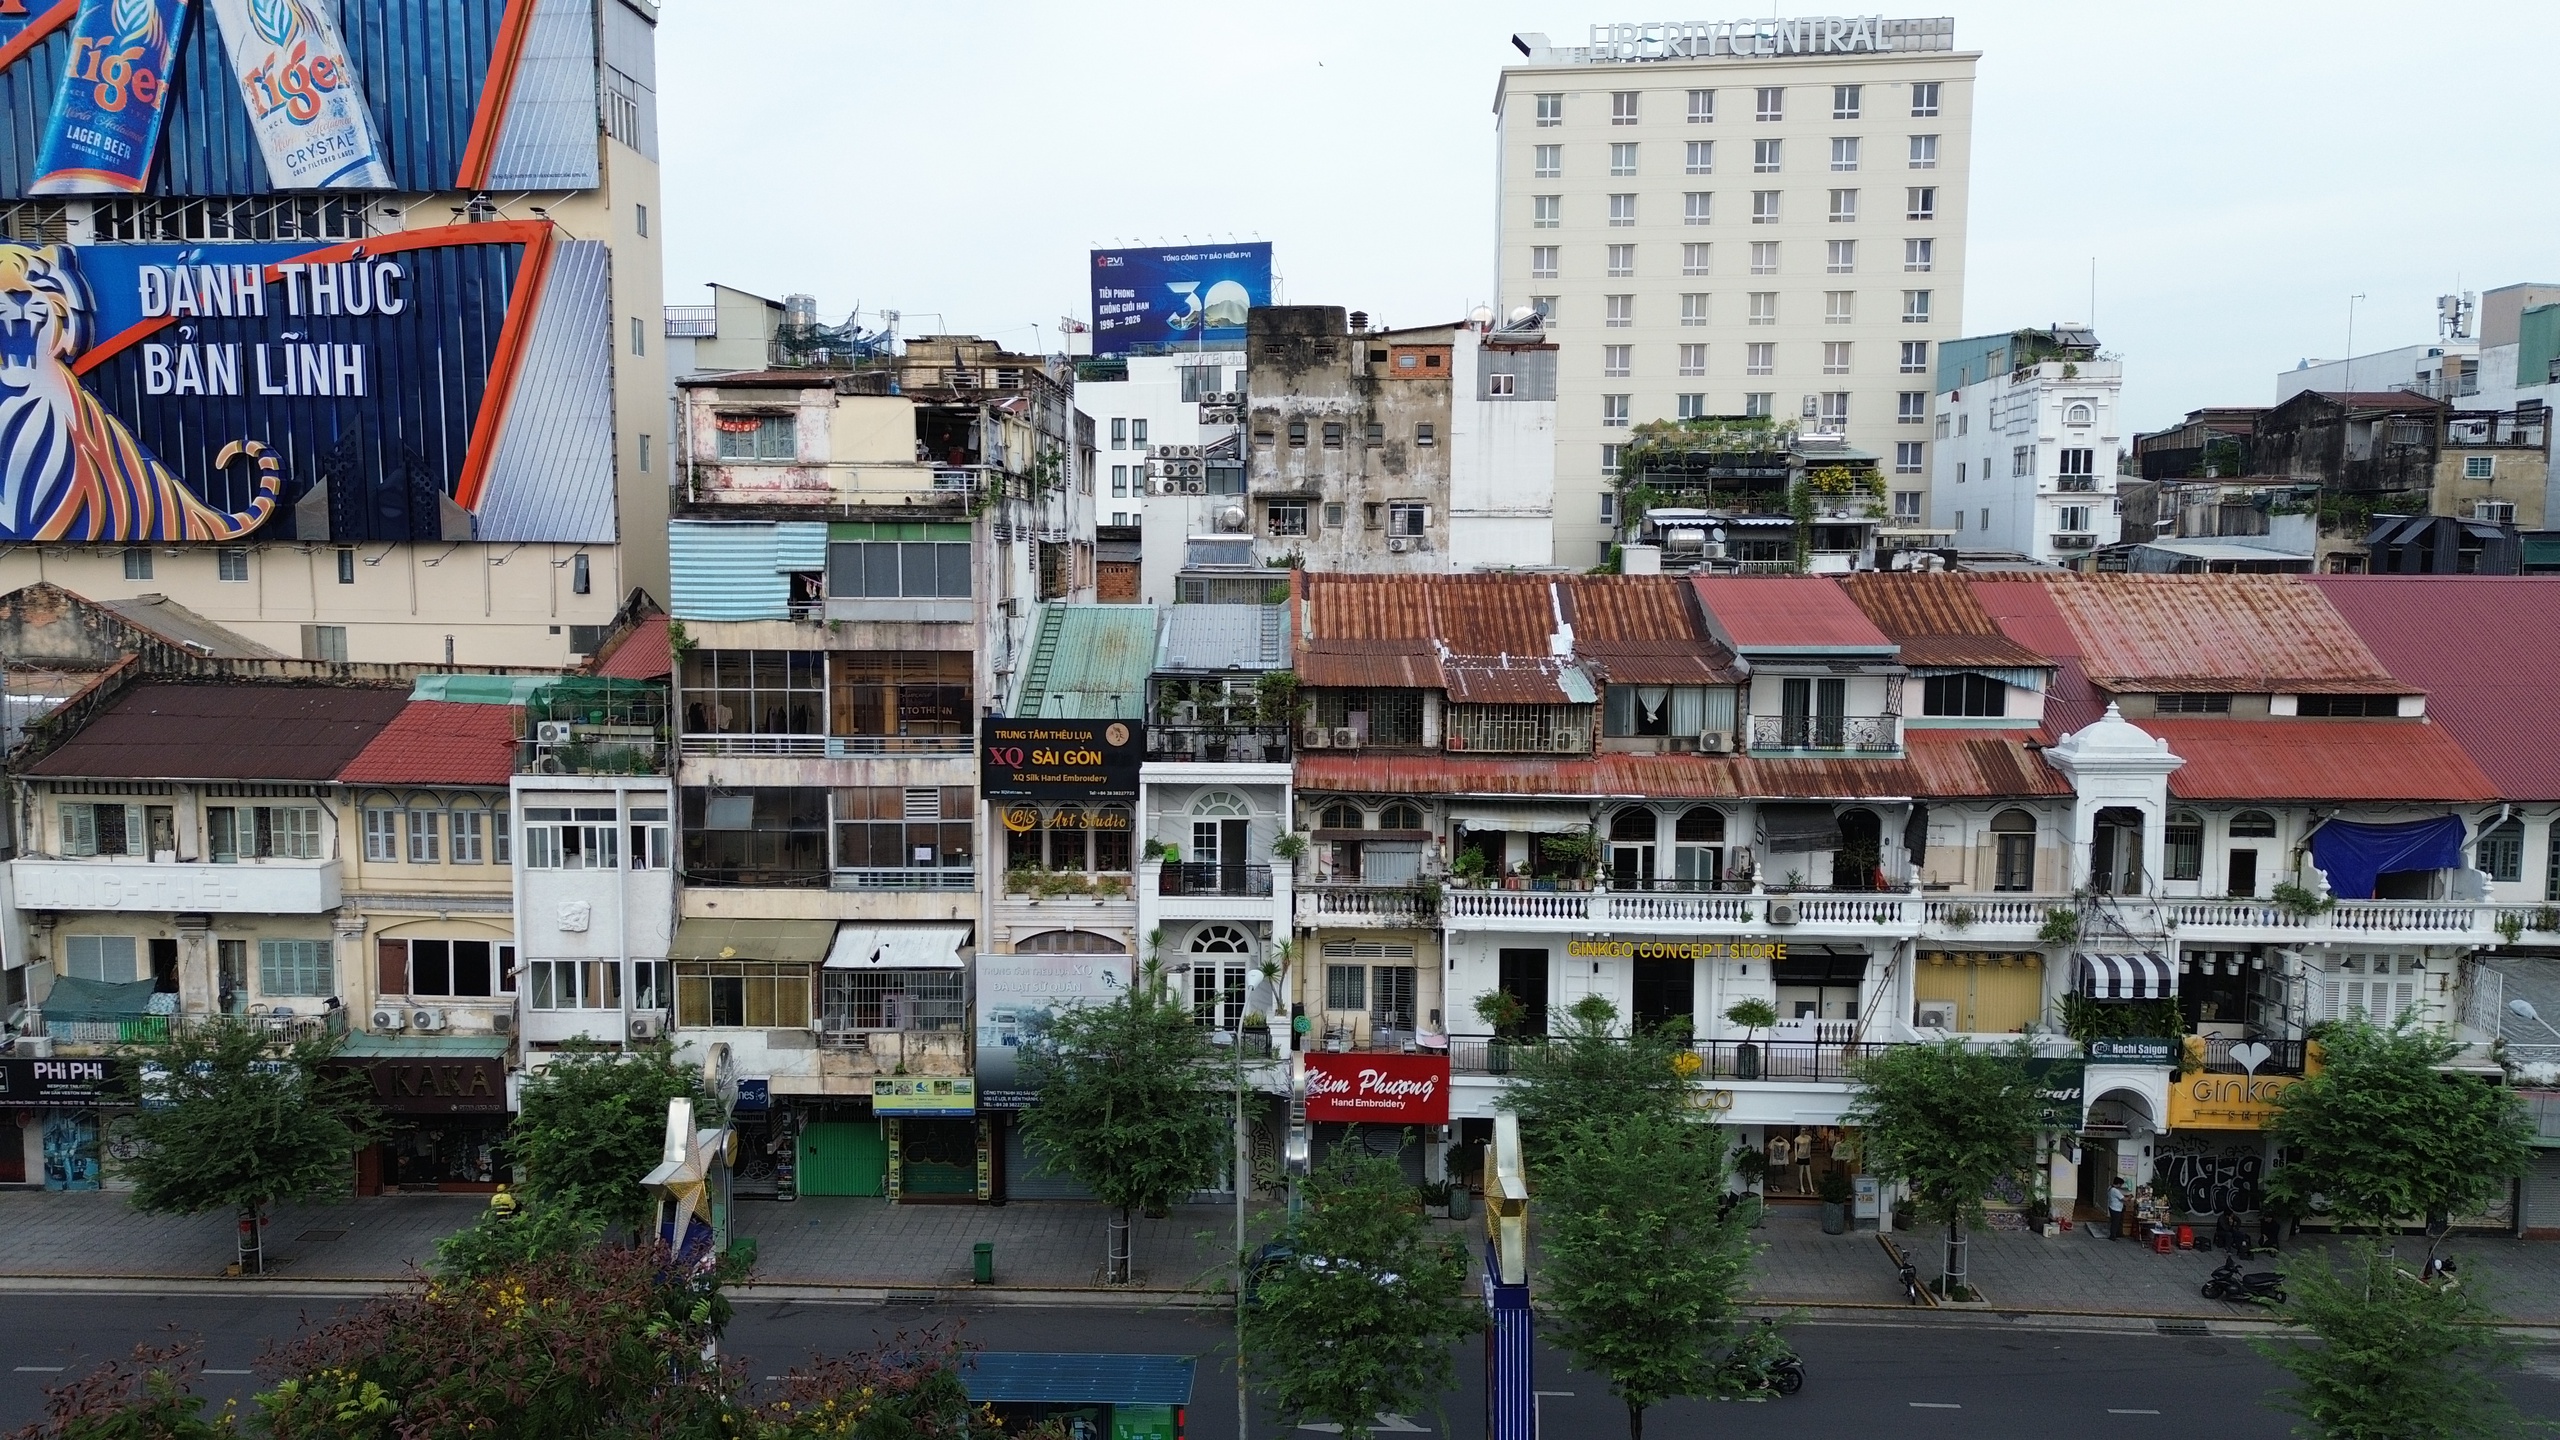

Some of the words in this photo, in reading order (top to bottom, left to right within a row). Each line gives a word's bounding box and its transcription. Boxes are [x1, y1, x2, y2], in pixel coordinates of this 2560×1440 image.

[67, 36, 169, 112] Tiger
[242, 39, 351, 124] Tiger
[66, 125, 102, 147] LAGER
[103, 136, 132, 160] BEER
[71, 142, 99, 157] ORIGINAL
[286, 132, 354, 169] CRYSTAL
[1106, 256, 1123, 264] PVI
[1180, 253, 1199, 261] CÔNG
[138, 250, 268, 317] ĐÁNH
[278, 245, 407, 316] THỨC
[1113, 288, 1135, 298] PHONG
[1099, 303, 1120, 314] KHÔNG
[1099, 320, 1115, 331] 1996
[1124, 316, 1141, 326] 2026
[143, 325, 243, 397] BẢN
[256, 332, 367, 397] LĨNH
[995, 730, 1027, 740] TRUNG
[1029, 729, 1049, 740] TÂM
[1050, 729, 1073, 740] THÊU
[1074, 731, 1093, 743] LỤA
[988, 747, 1024, 769] XQ
[1031, 746, 1059, 765] SÀI
[1063, 746, 1102, 765] GÒN
[1012, 774, 1025, 782] XQ
[1026, 773, 1040, 782] Silk
[1041, 773, 1061, 782] Hand
[1062, 774, 1108, 784] Embroidery
[1043, 811, 1076, 828] Art
[1079, 812, 1126, 829] Studio
[1568, 941, 1634, 957] GINKGO
[1639, 942, 1723, 959] CONCEPT
[1729, 943, 1788, 960] STORE
[1072, 964, 1093, 978] XQ
[2112, 1044, 2137, 1054] Hachi
[2138, 1044, 2168, 1056] Saigon
[390, 1065, 494, 1097] KAKA
[1308, 1069, 1350, 1094] Kim
[2034, 1087, 2081, 1100] Craft
[1331, 1098, 1354, 1107] Hand
[1355, 1098, 1406, 1110] Embroidery
[2273, 1158, 2284, 1168] 86
